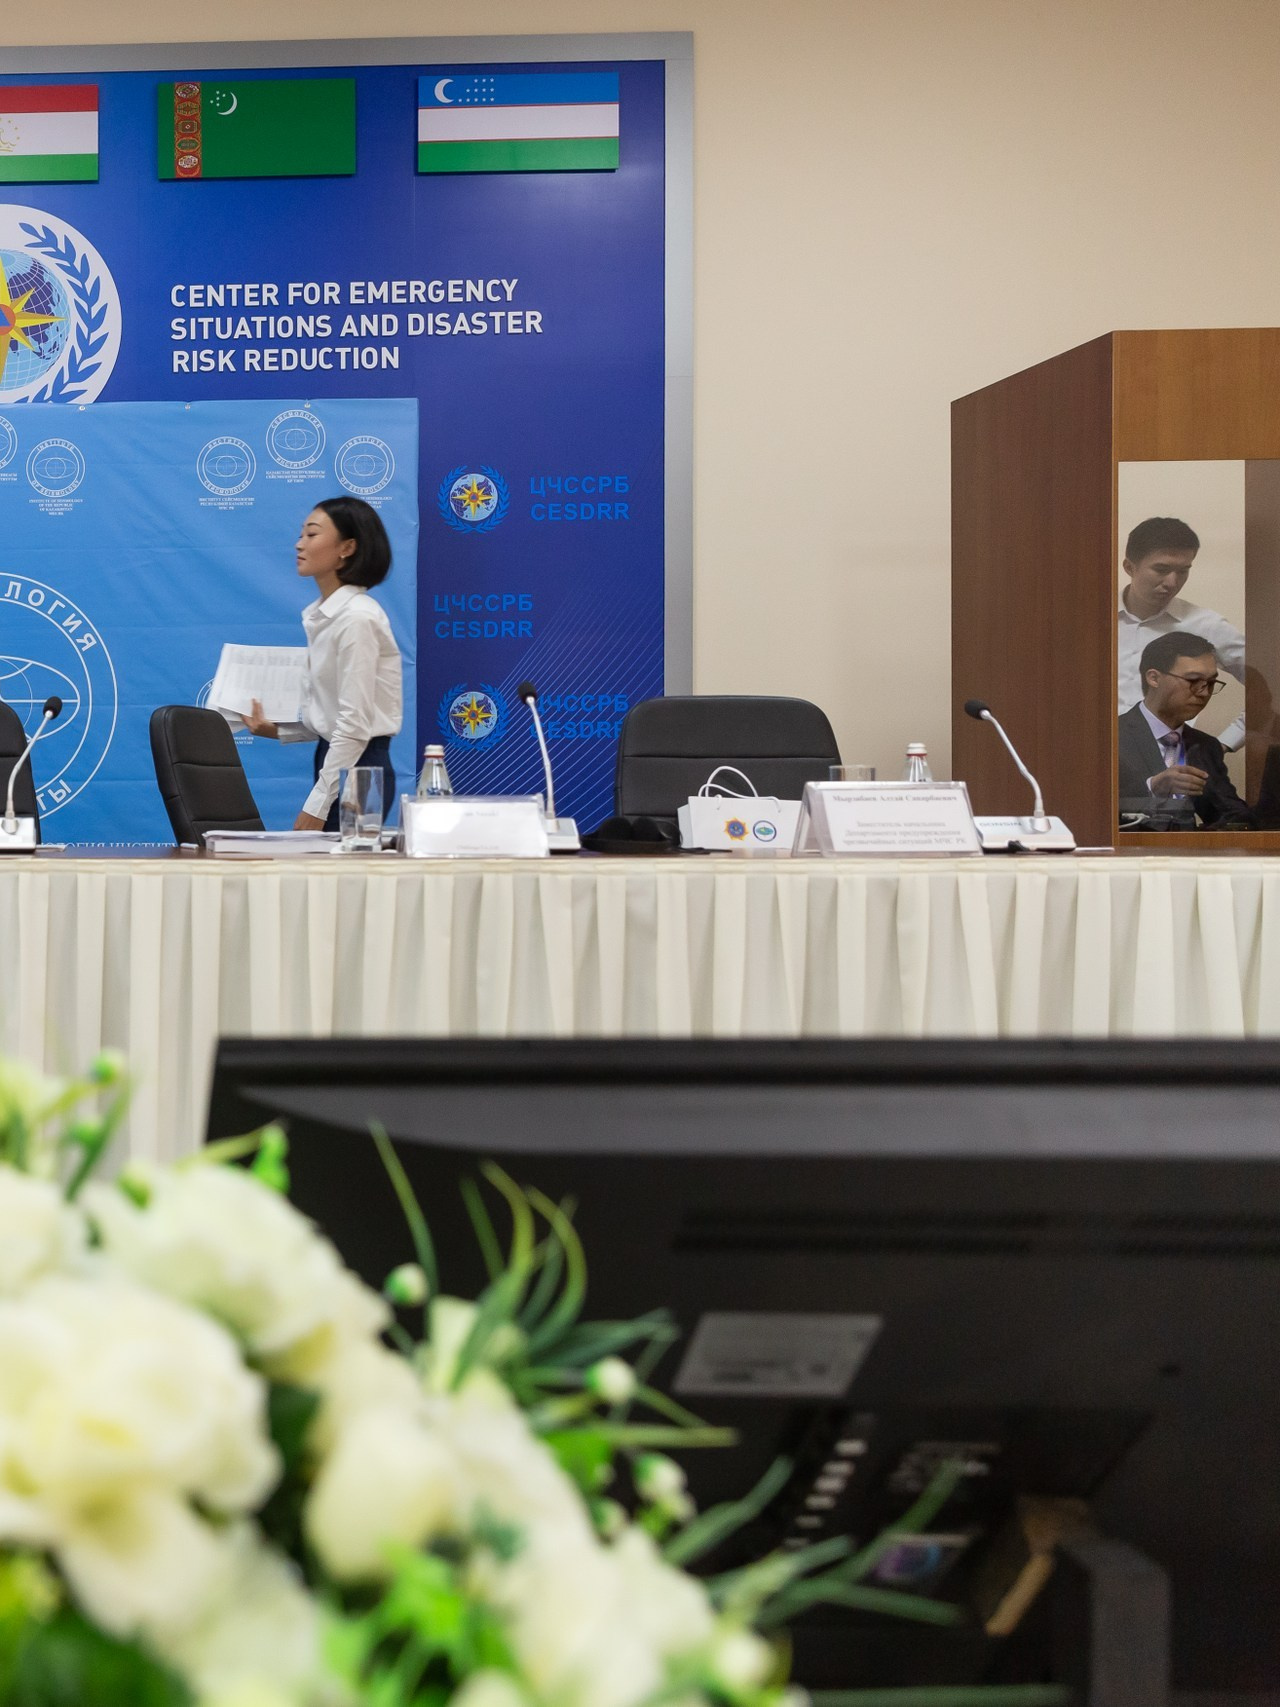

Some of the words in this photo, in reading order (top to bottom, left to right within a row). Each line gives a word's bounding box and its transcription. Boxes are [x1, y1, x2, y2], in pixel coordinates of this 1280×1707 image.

[171, 283, 279, 308] CENTER
[288, 282, 341, 305] FOR
[349, 279, 519, 304] EMERGENCY
[170, 315, 333, 340] SITUATIONS
[339, 313, 399, 337] AND
[407, 311, 543, 336] DISASTER
[173, 350, 237, 373] RISK
[244, 347, 399, 372] REDUCTION
[530, 475, 630, 498] ЦЧССРБ
[530, 502, 630, 521] CESDRR
[434, 593, 533, 615] ЦЧССРБ
[435, 620, 533, 639] CESDRR
